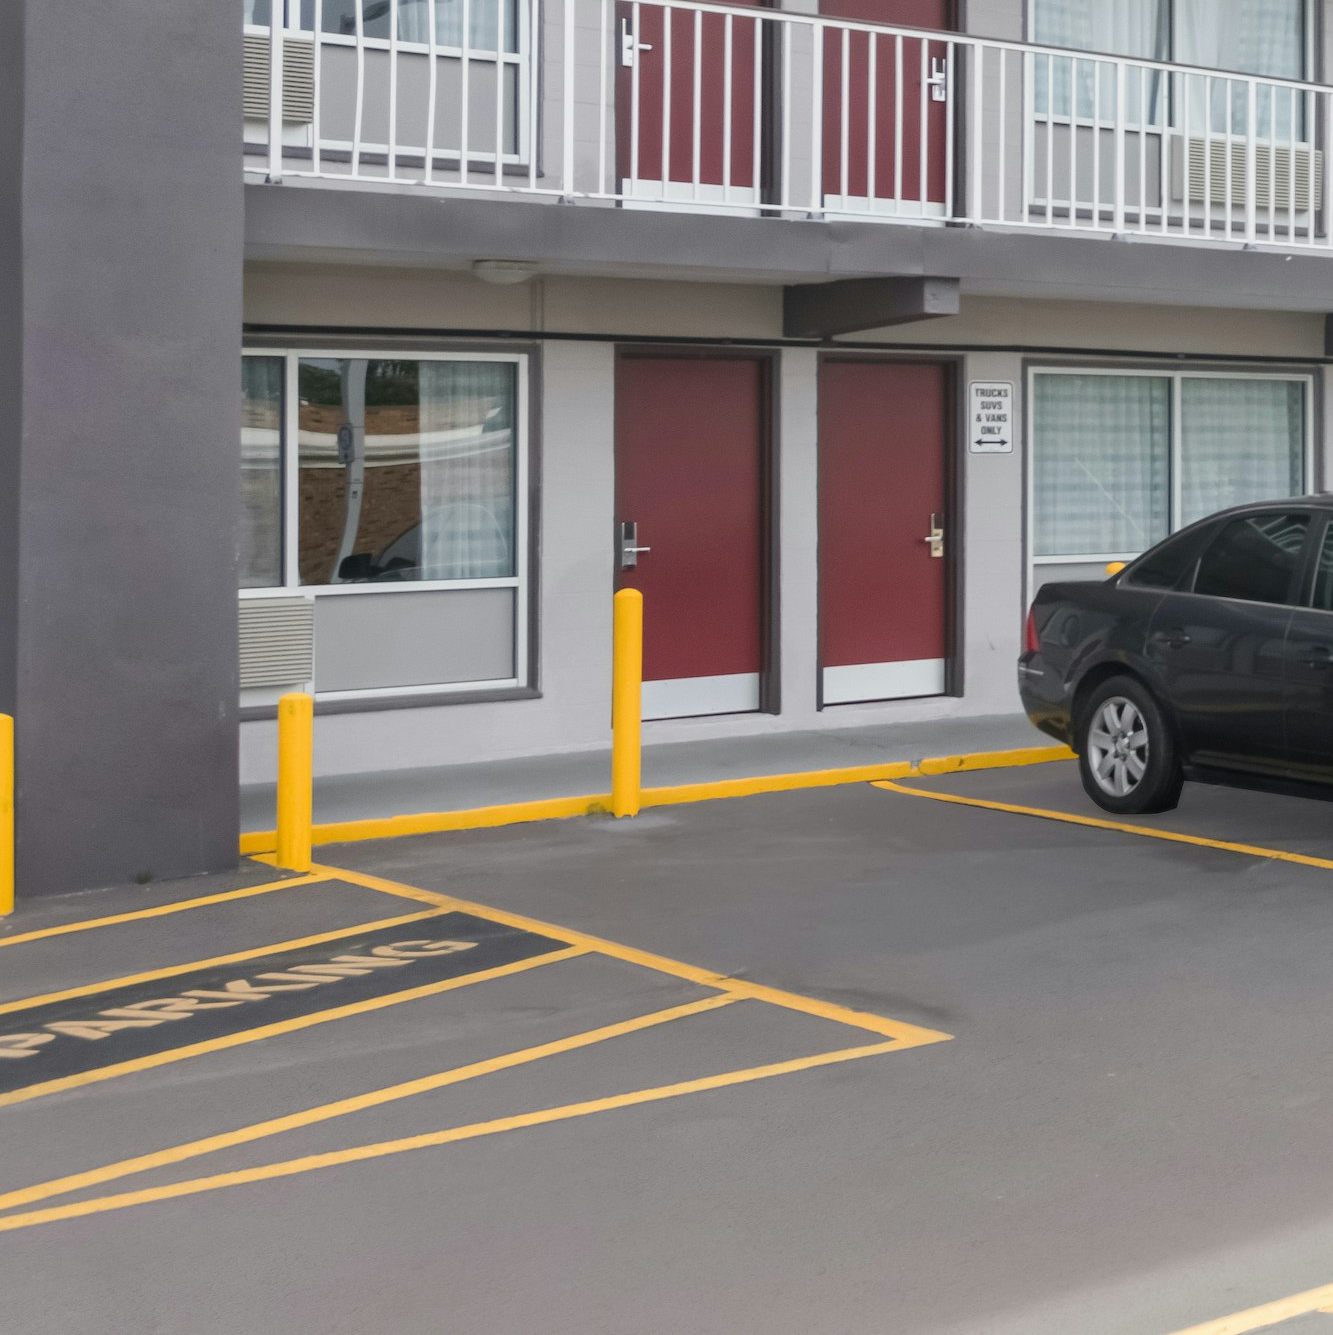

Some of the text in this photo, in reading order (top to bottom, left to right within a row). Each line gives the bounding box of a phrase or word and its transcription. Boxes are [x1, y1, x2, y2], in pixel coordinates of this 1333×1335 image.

[975, 388, 1008, 398] TRUCKS
[980, 400, 1003, 410] SUVS
[975, 413, 1007, 422] & VANS
[981, 425, 1002, 435] ONLY
